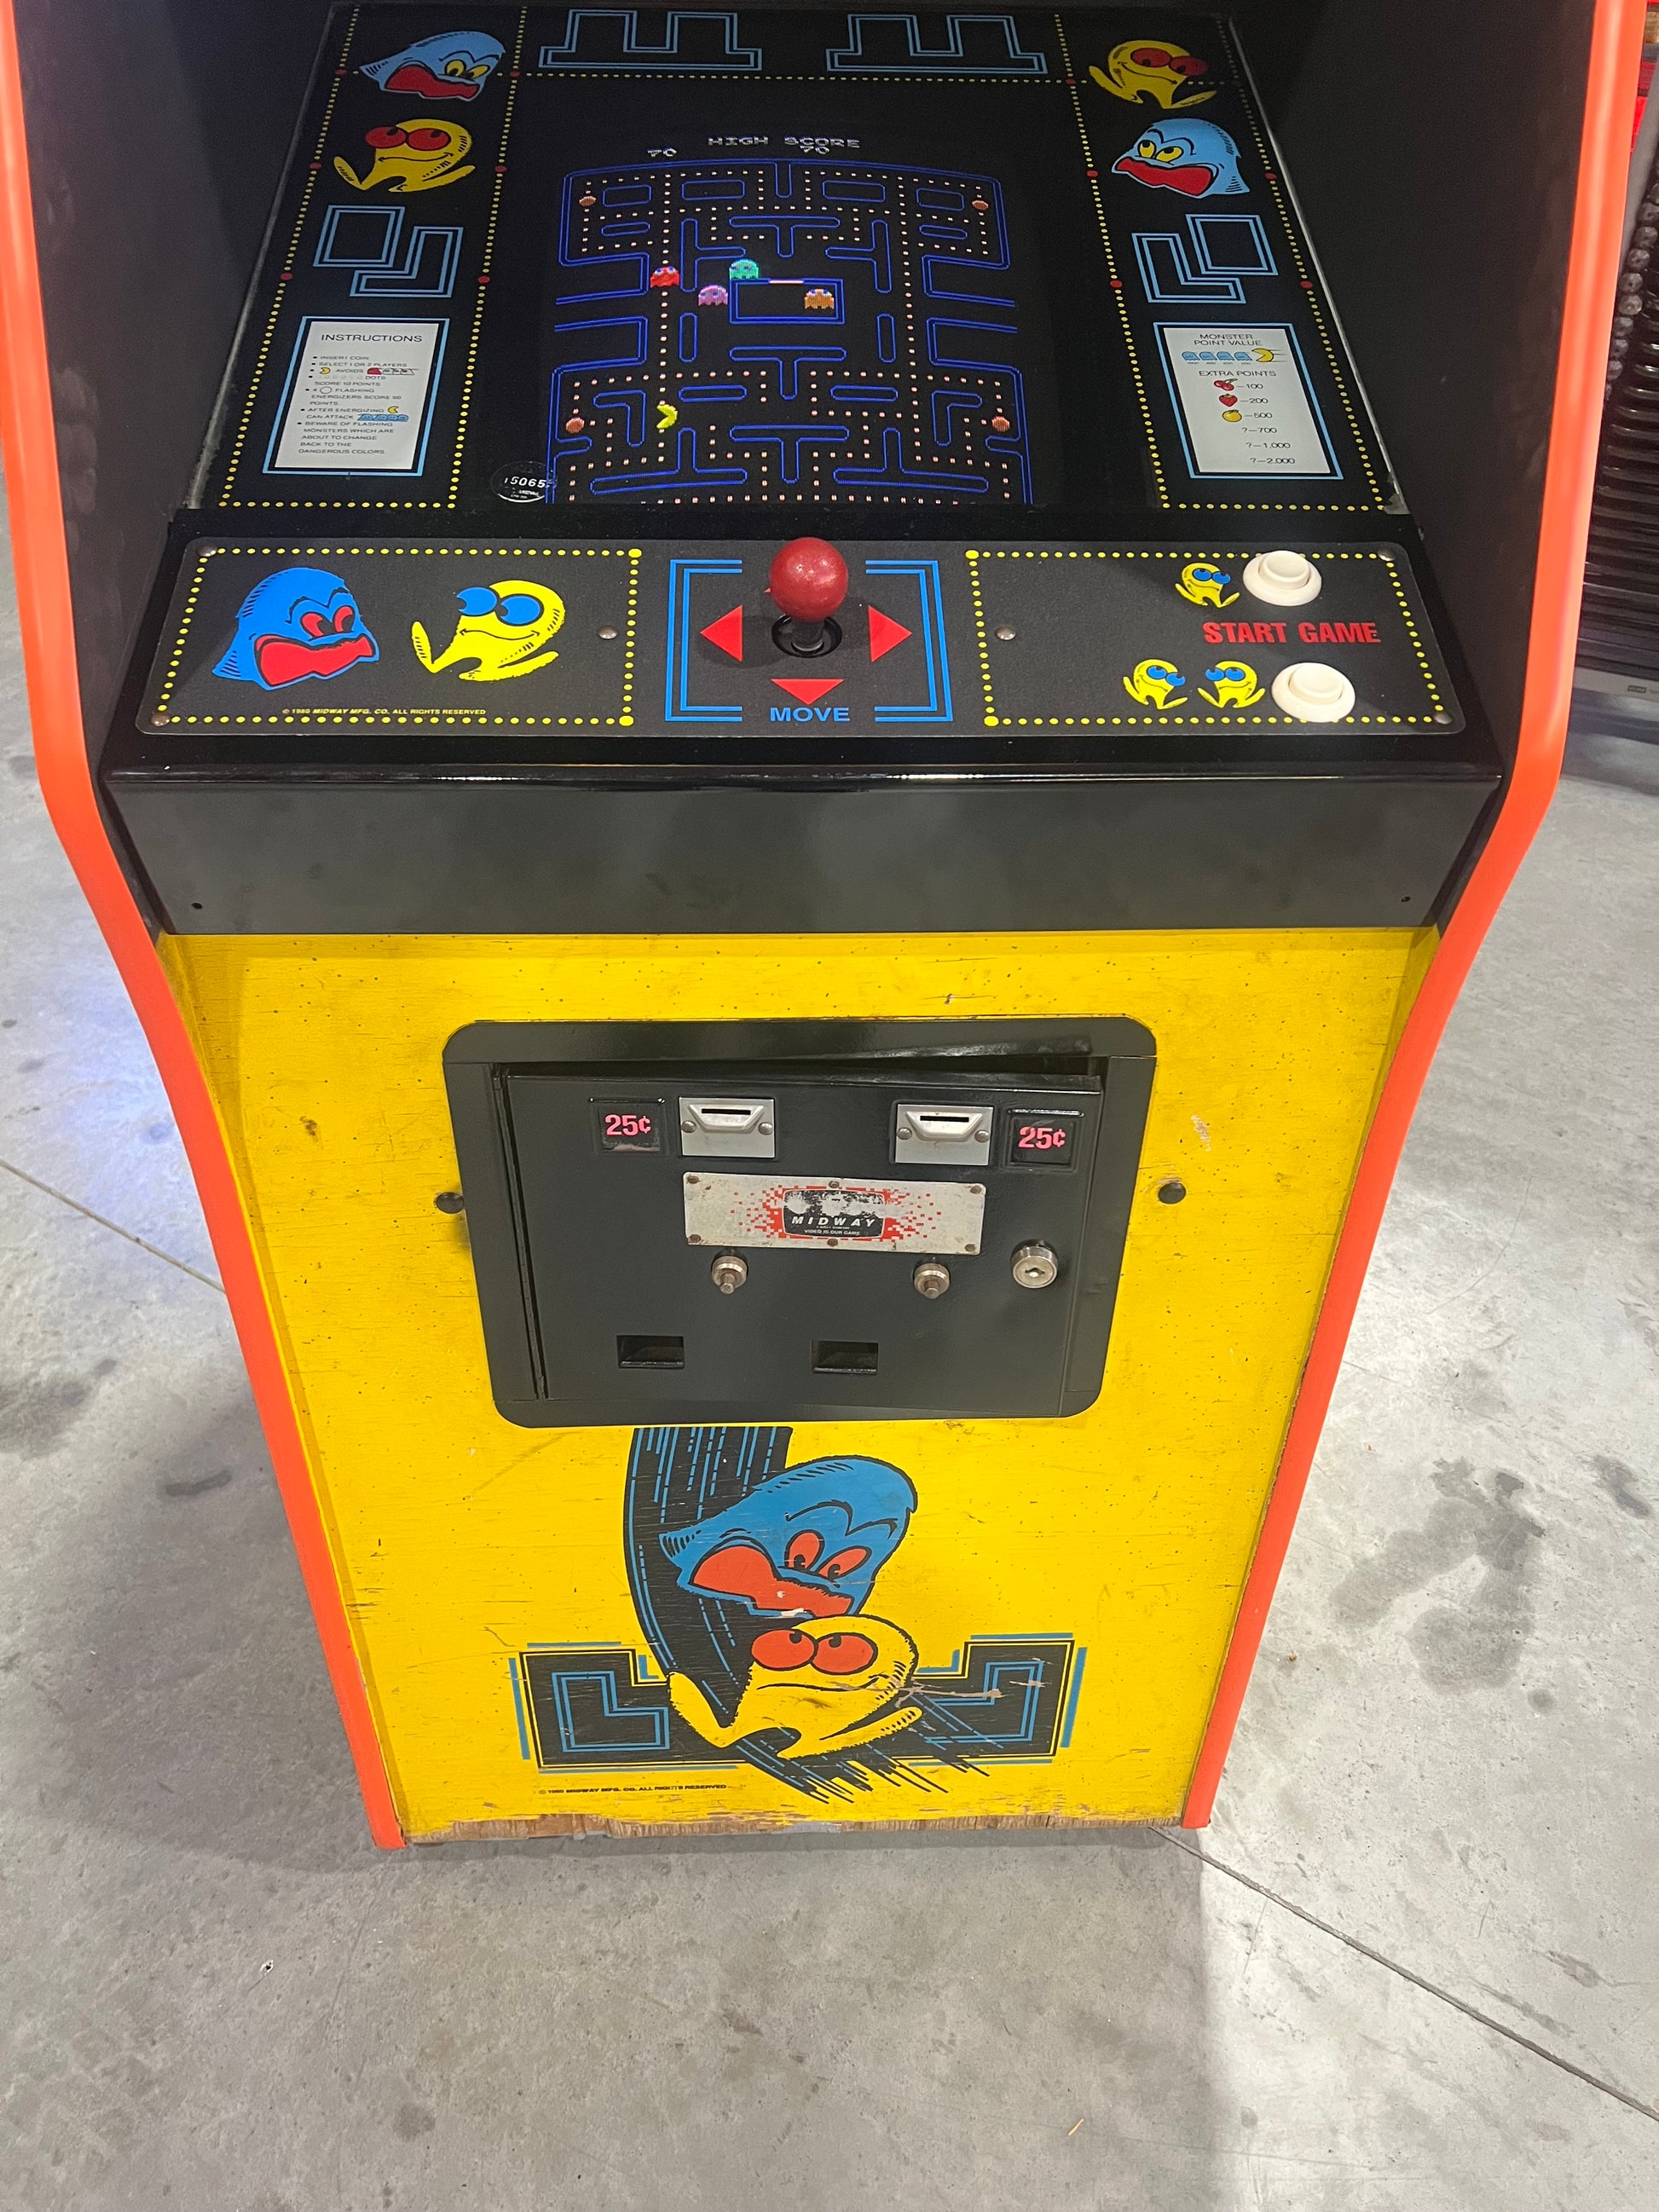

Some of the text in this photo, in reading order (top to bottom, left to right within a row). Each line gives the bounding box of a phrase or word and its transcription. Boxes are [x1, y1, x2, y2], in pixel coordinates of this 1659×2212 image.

[708, 136, 860, 148] HIGH SCORE
[647, 147, 678, 158] 70
[321, 334, 423, 343] INSTRUCTIONS
[1202, 621, 1381, 644] START GAME
[770, 707, 850, 722] MOVE
[604, 1114, 651, 1136] 25¢
[1018, 1126, 1066, 1150] 25¢
[791, 1216, 876, 1227] MIDWAY
